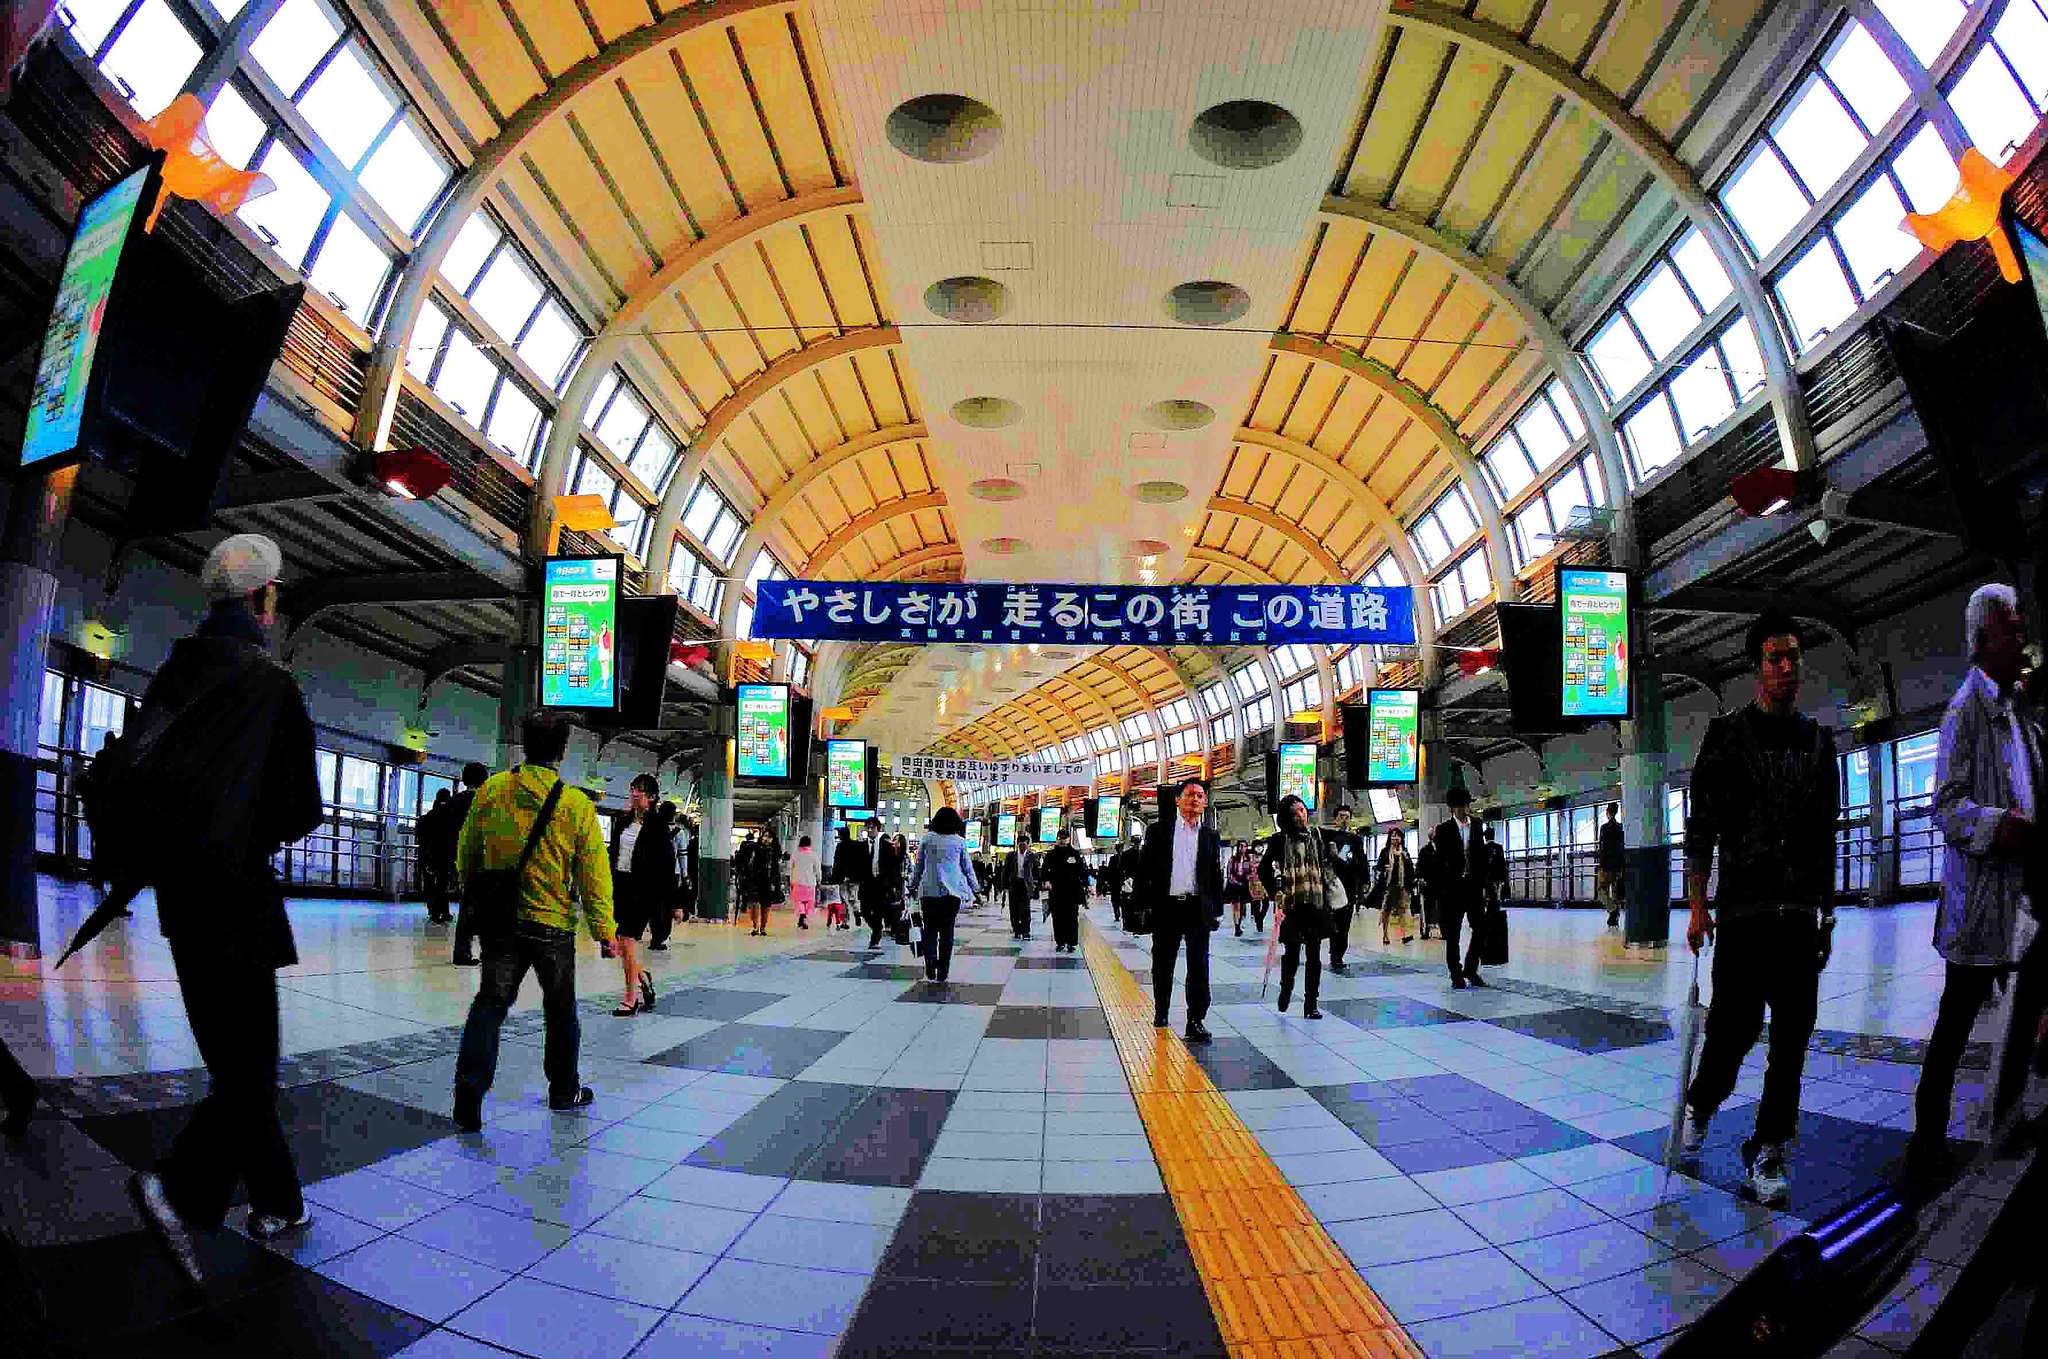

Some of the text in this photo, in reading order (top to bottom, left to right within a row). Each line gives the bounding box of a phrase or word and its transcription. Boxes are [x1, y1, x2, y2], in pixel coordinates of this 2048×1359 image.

[782, 587, 1388, 630] やさしさが 走るこの街 この道路
